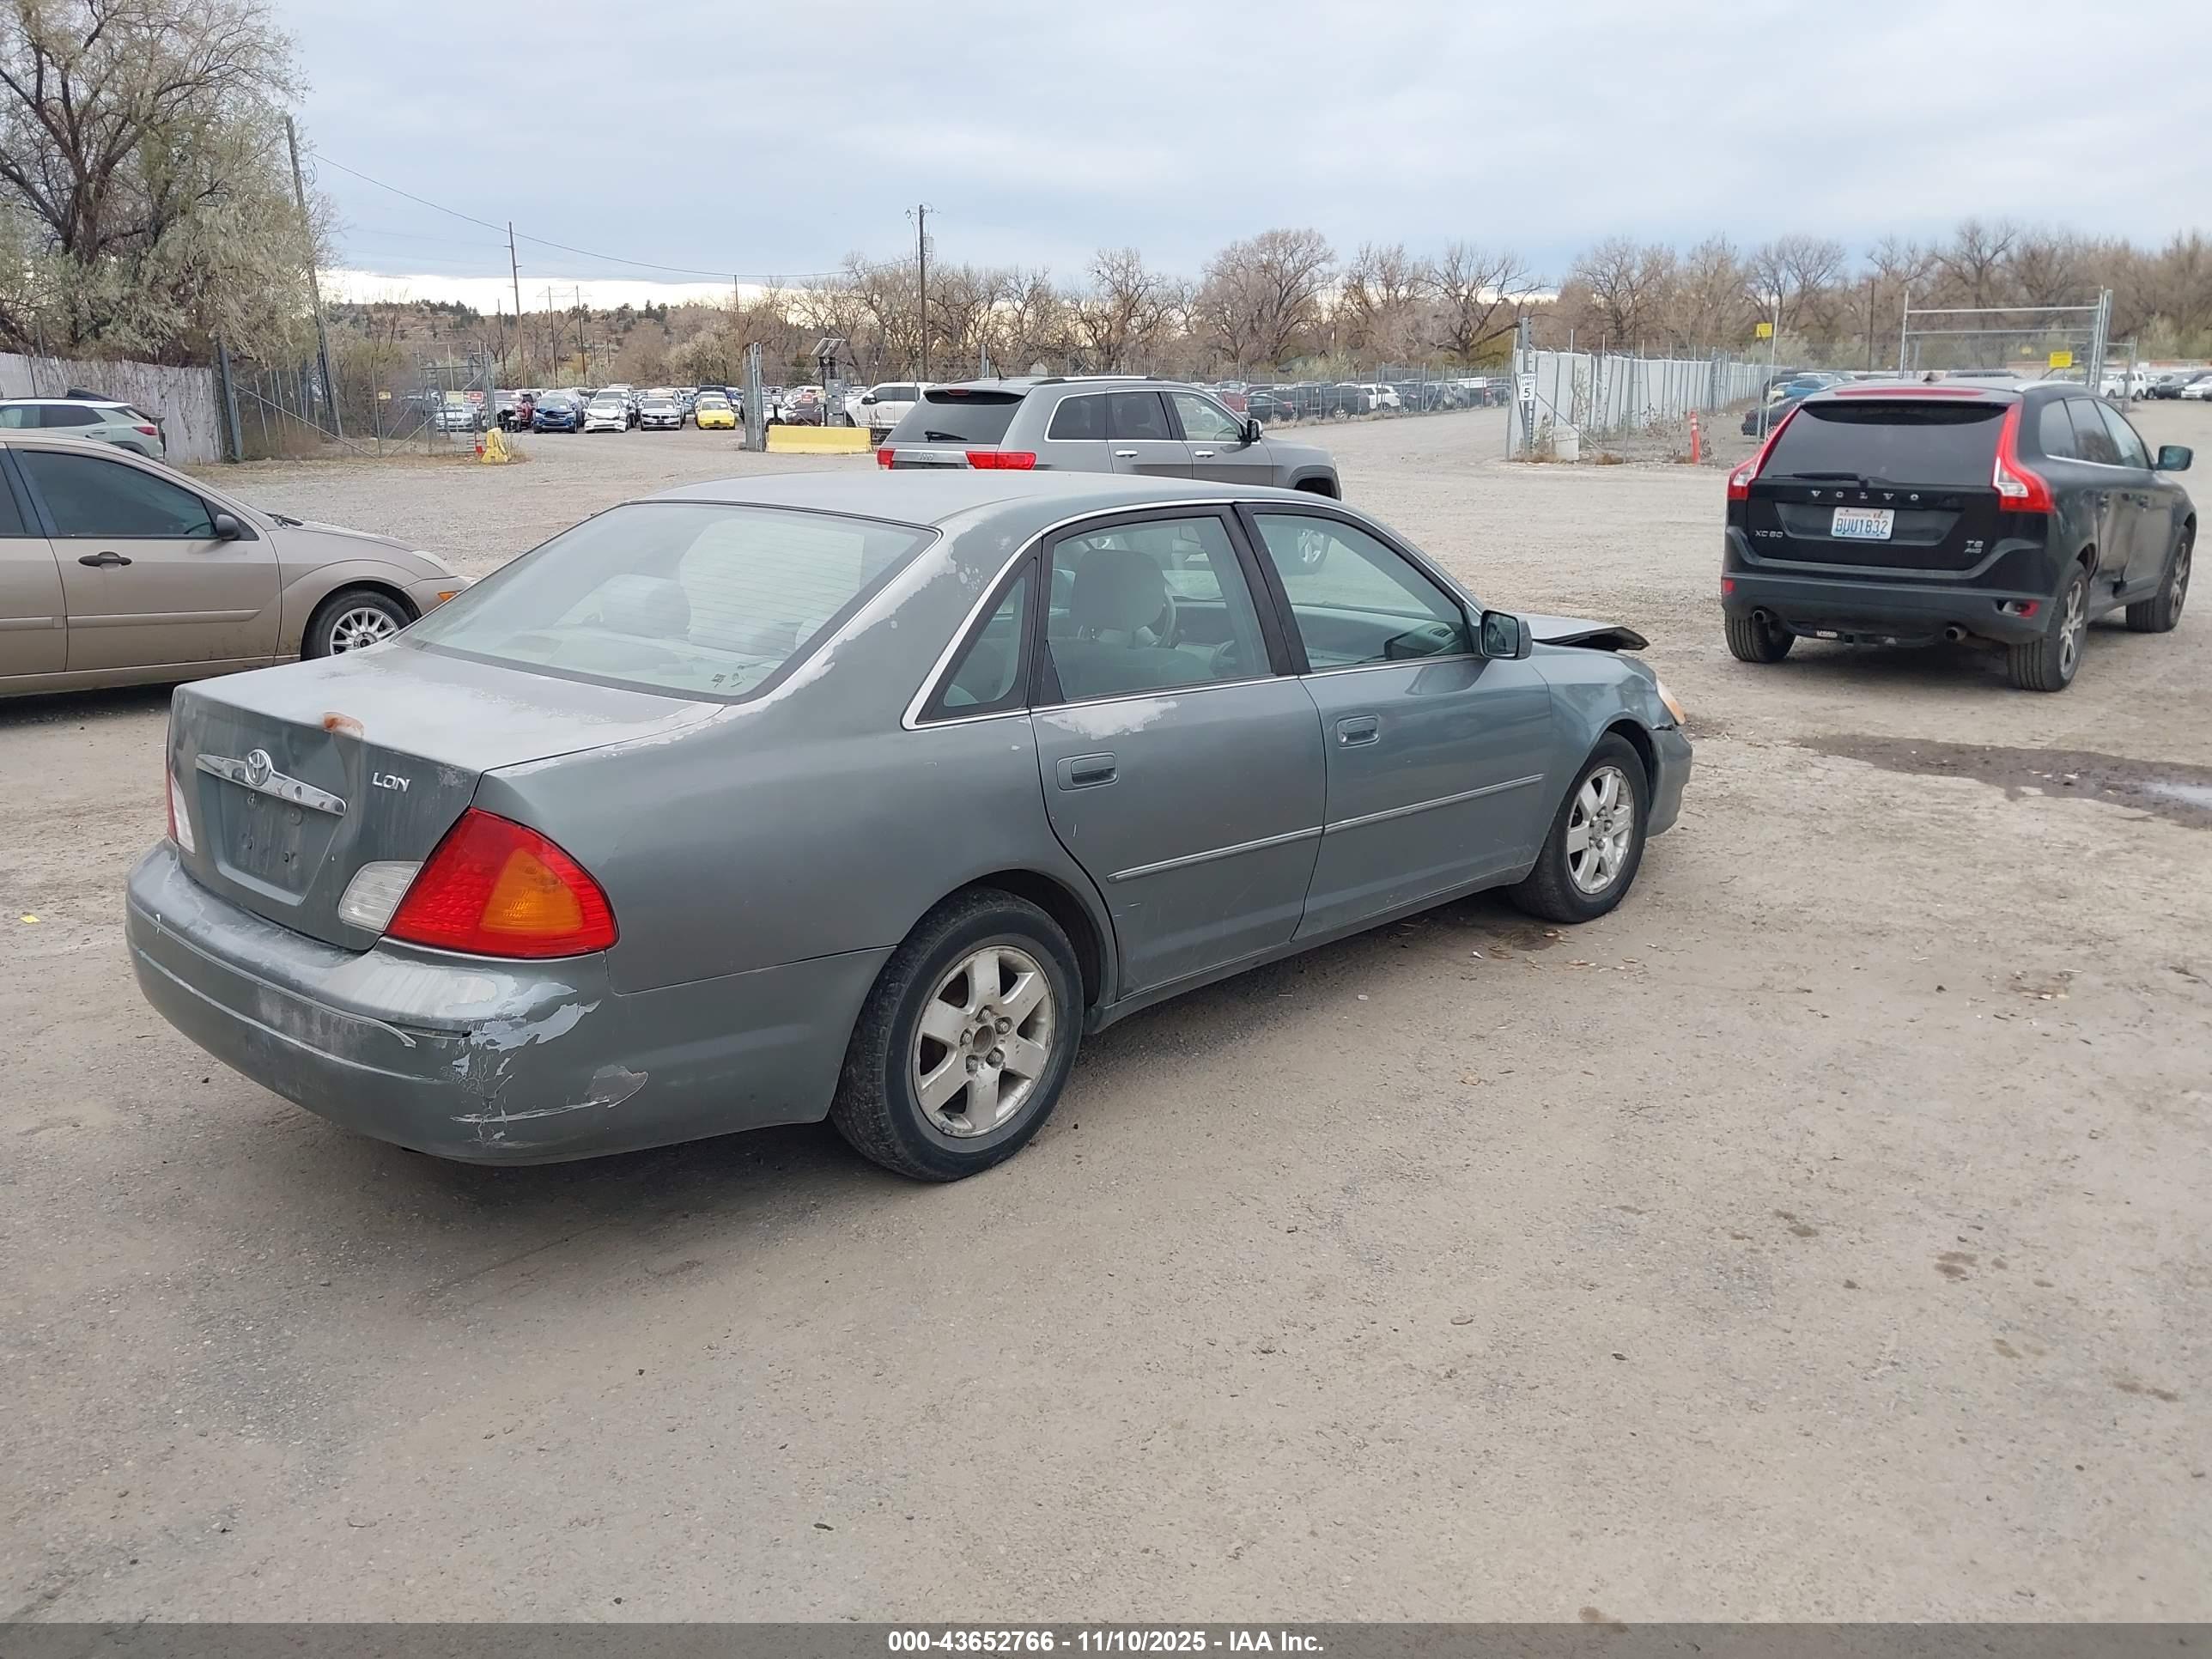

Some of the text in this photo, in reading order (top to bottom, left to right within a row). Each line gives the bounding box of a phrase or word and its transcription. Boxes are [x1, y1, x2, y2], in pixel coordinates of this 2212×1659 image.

[1523, 387, 1531, 398] 5
[1811, 490, 1919, 501] VOLVO
[1835, 518, 1888, 535] BUU1832
[372, 772, 411, 792] LON
